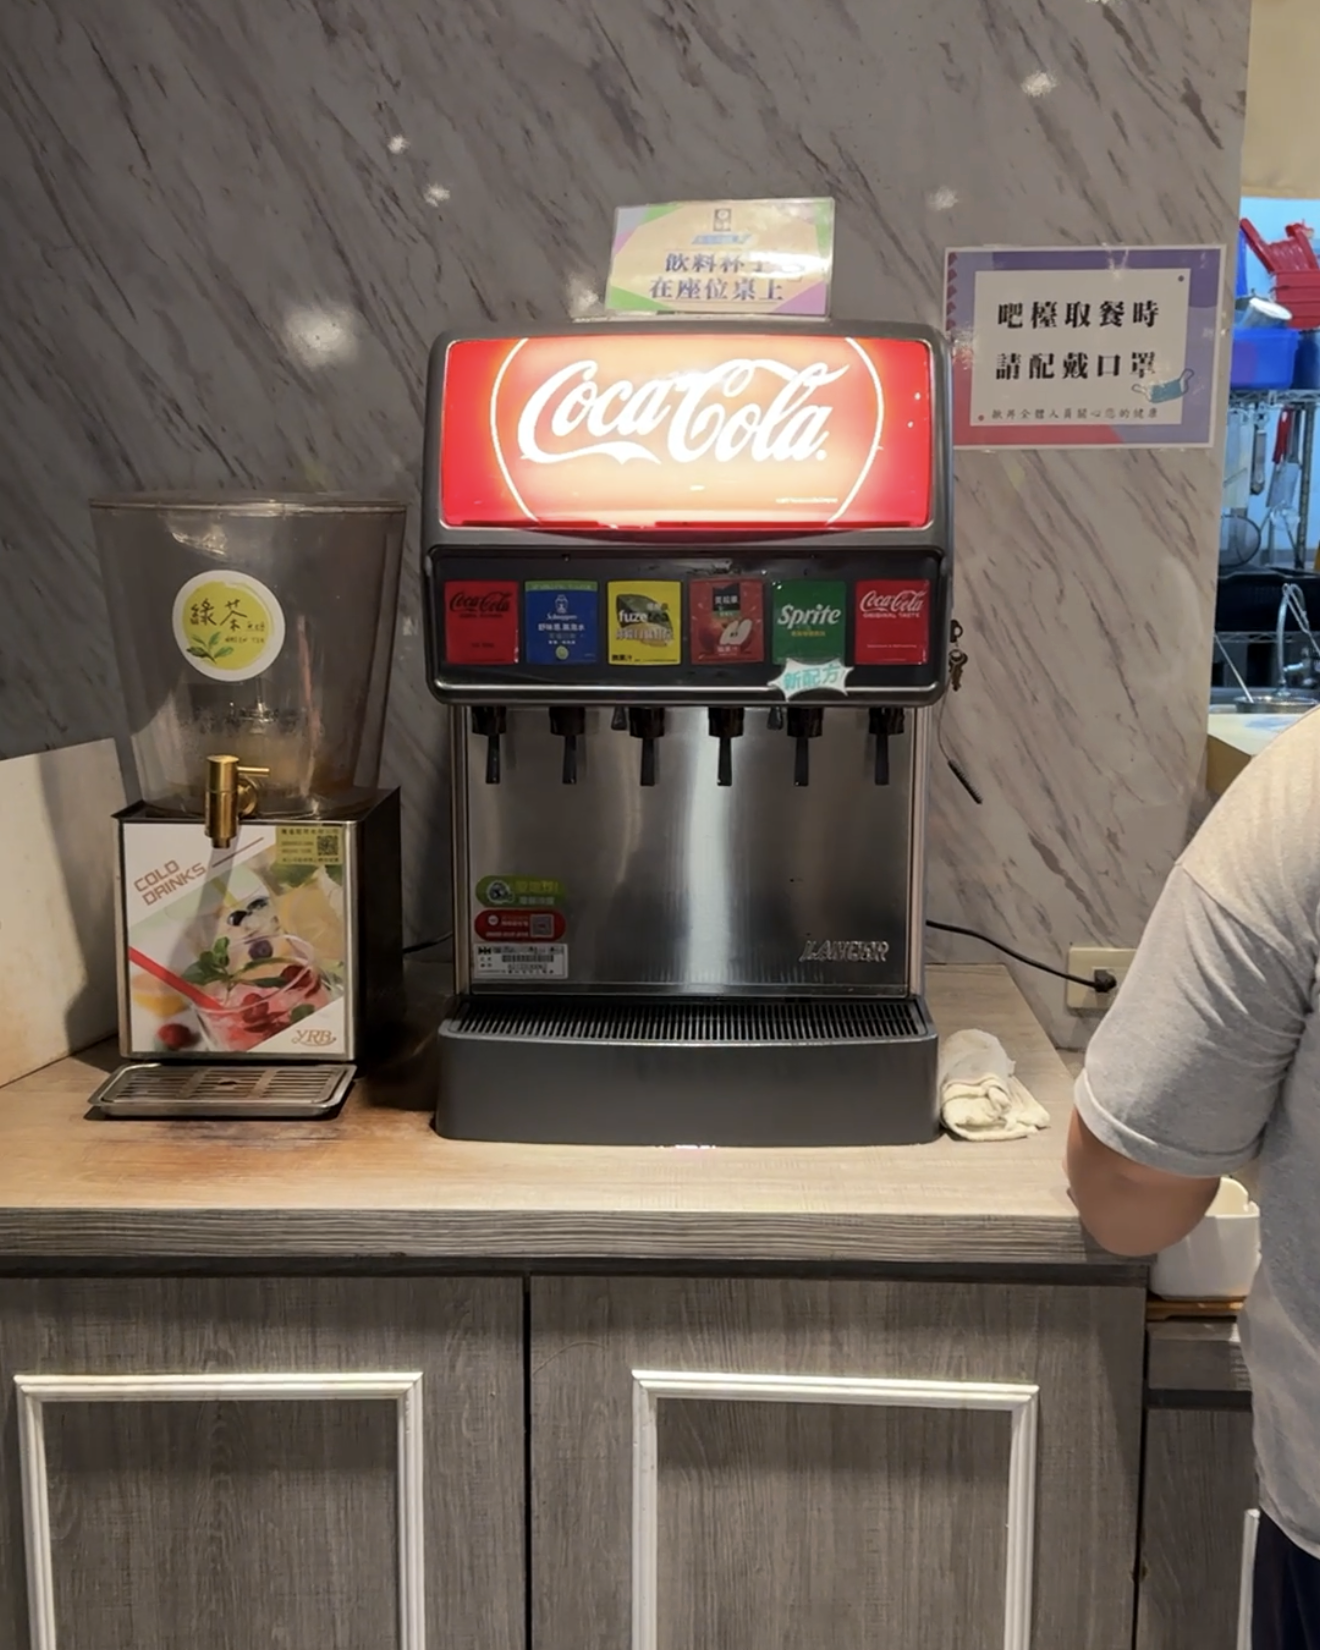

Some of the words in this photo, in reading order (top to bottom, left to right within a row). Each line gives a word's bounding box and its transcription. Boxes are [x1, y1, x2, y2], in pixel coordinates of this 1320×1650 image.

[649, 276, 784, 301] 在座位桌上
[997, 299, 1159, 329] 吧檯取餐時
[995, 351, 1157, 380] 請配戴口罩
[190, 598, 248, 632] 綠茶
[618, 609, 648, 623] fuze
[777, 603, 842, 630] Sprite
[784, 663, 842, 690] 新配方
[133, 859, 180, 894] COLD
[142, 863, 206, 906] DRINKS
